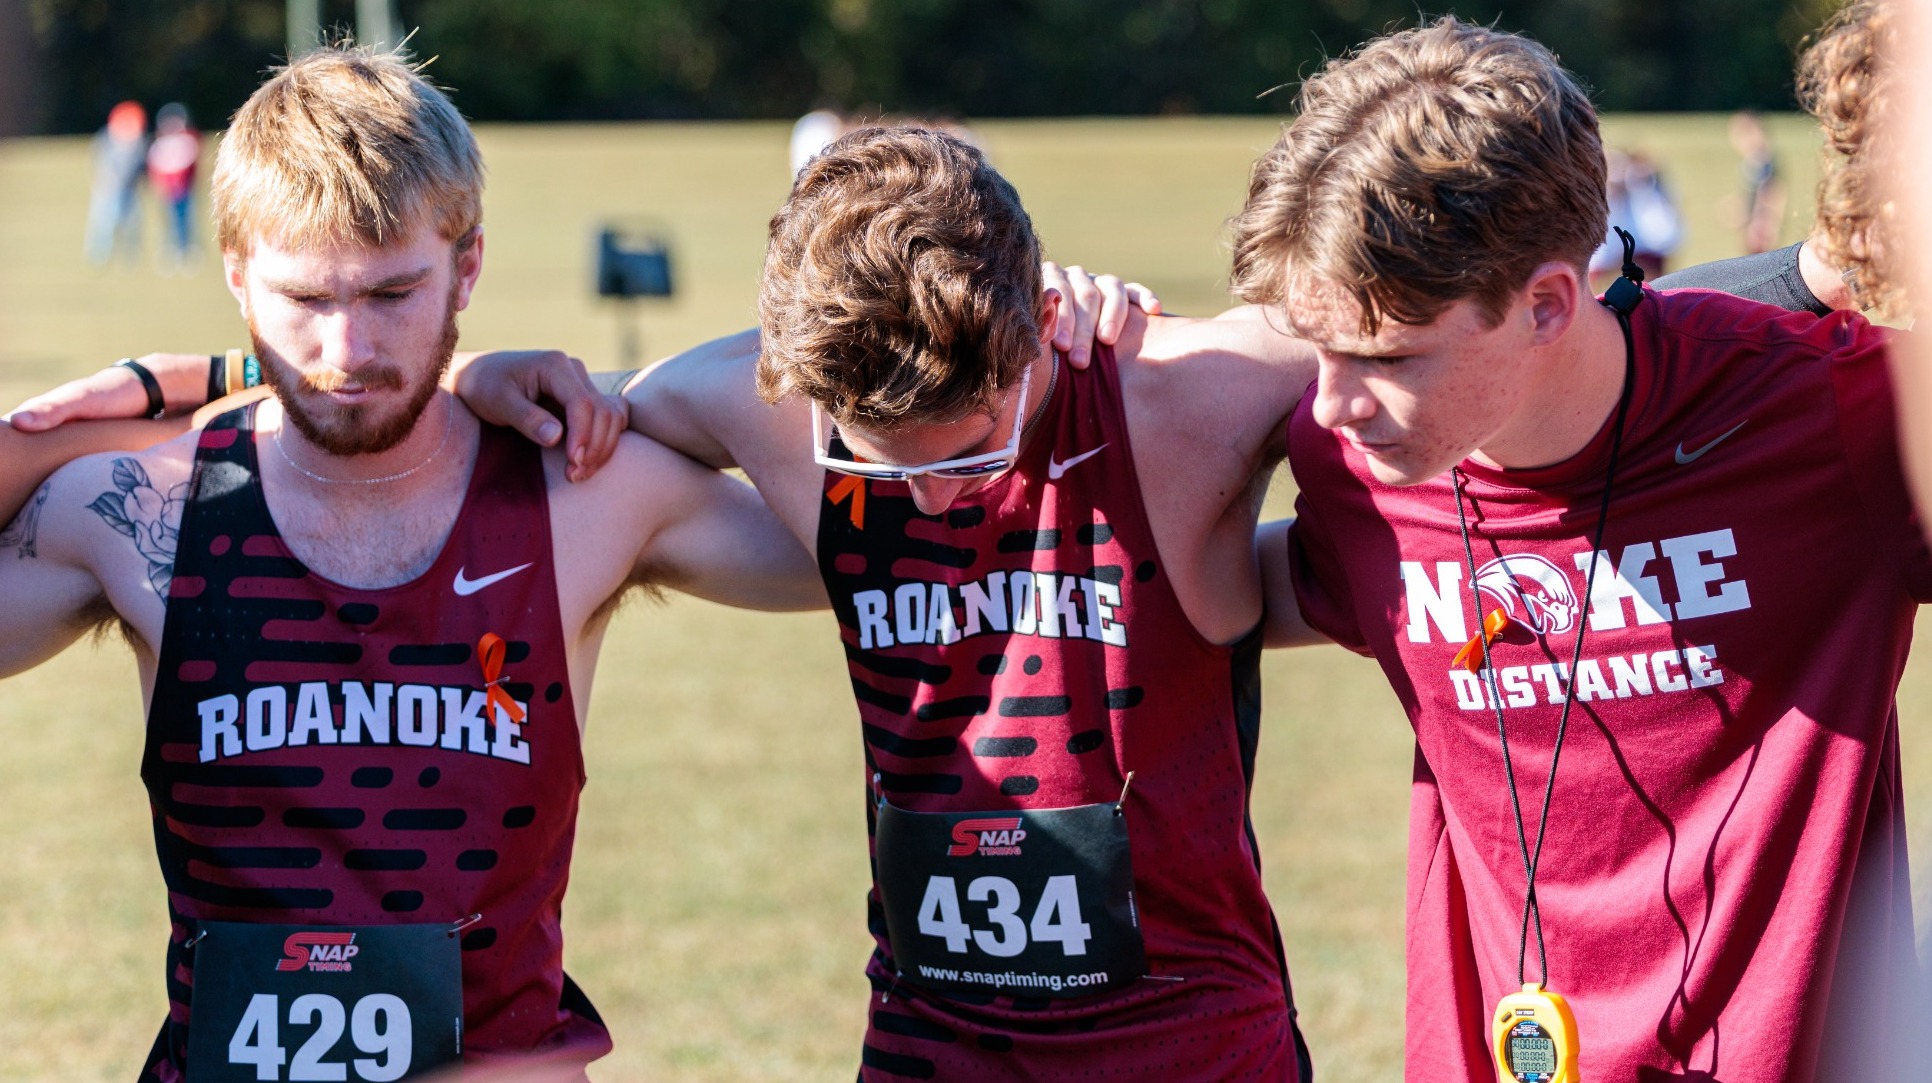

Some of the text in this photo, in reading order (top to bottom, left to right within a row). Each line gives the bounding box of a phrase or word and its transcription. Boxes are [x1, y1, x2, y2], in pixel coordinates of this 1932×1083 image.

[852, 569, 1129, 651] ROANOKE
[1448, 643, 1725, 711] DISTANCE
[196, 680, 532, 767] ROANOKE
[946, 817, 1027, 856] SNAP
[978, 846, 1022, 856] TIMING
[917, 874, 1092, 957] 434
[275, 932, 359, 971] SNAP
[308, 961, 352, 972] TIMING
[918, 964, 1109, 991] www.snaptiming.com
[228, 993, 413, 1082] 429
